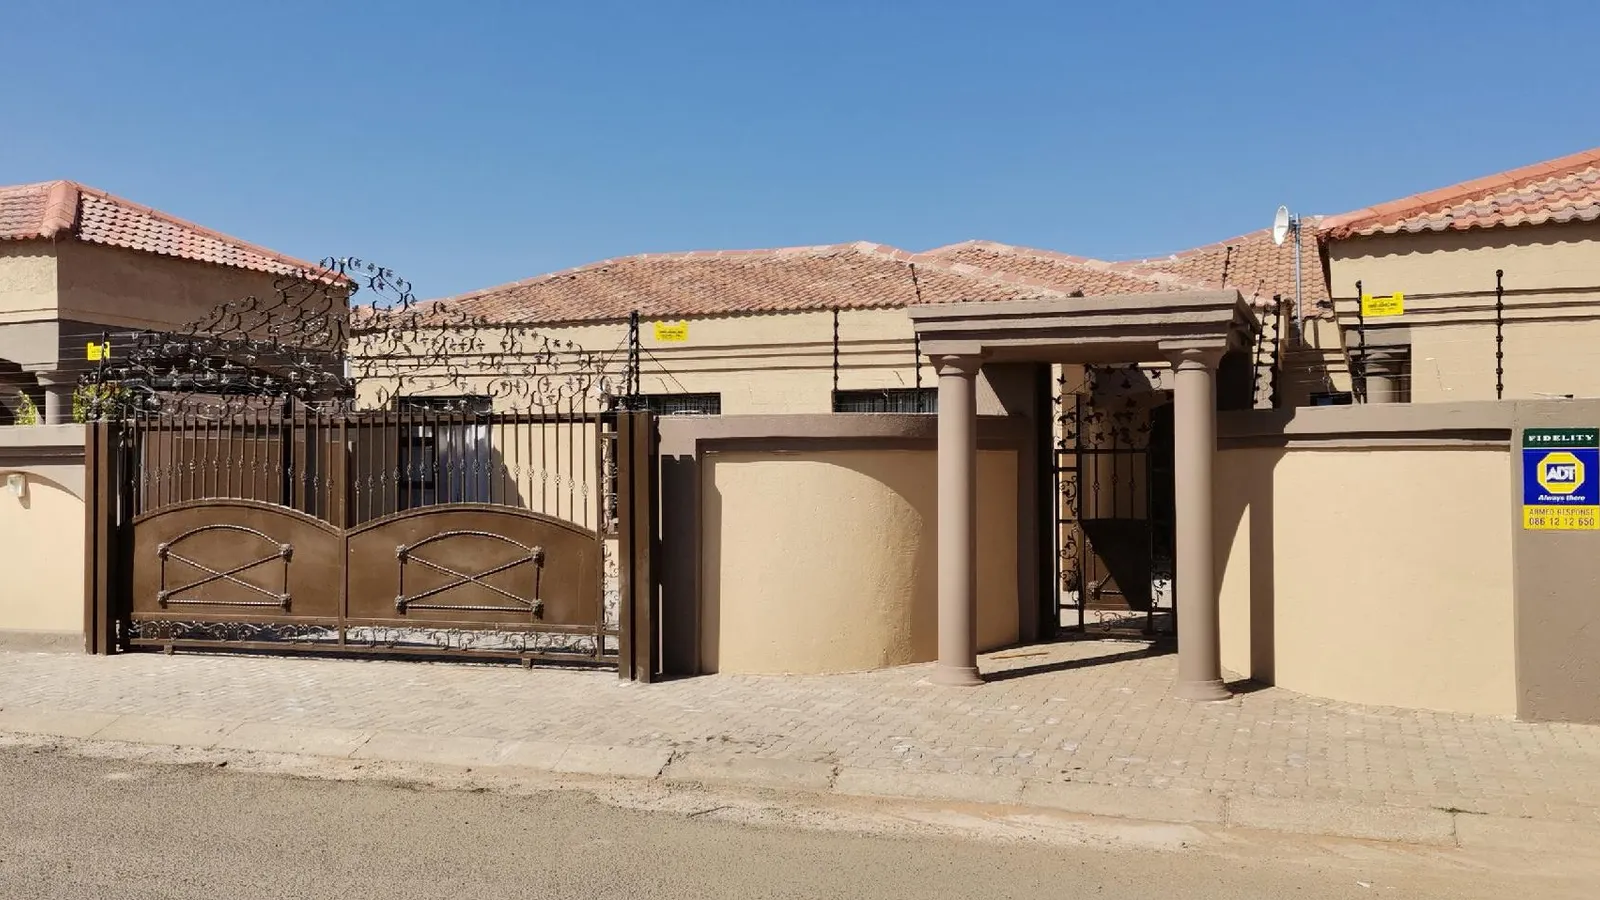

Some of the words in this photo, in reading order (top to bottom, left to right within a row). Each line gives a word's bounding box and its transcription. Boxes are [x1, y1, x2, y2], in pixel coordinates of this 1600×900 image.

[1528, 434, 1594, 442] FIDELITY
[1546, 465, 1576, 481] ADT
[1538, 494, 1565, 502] Always
[1529, 517, 1546, 526] 086
[1550, 517, 1560, 526] 12
[1565, 517, 1575, 526] 12
[1578, 517, 1595, 526] 650
